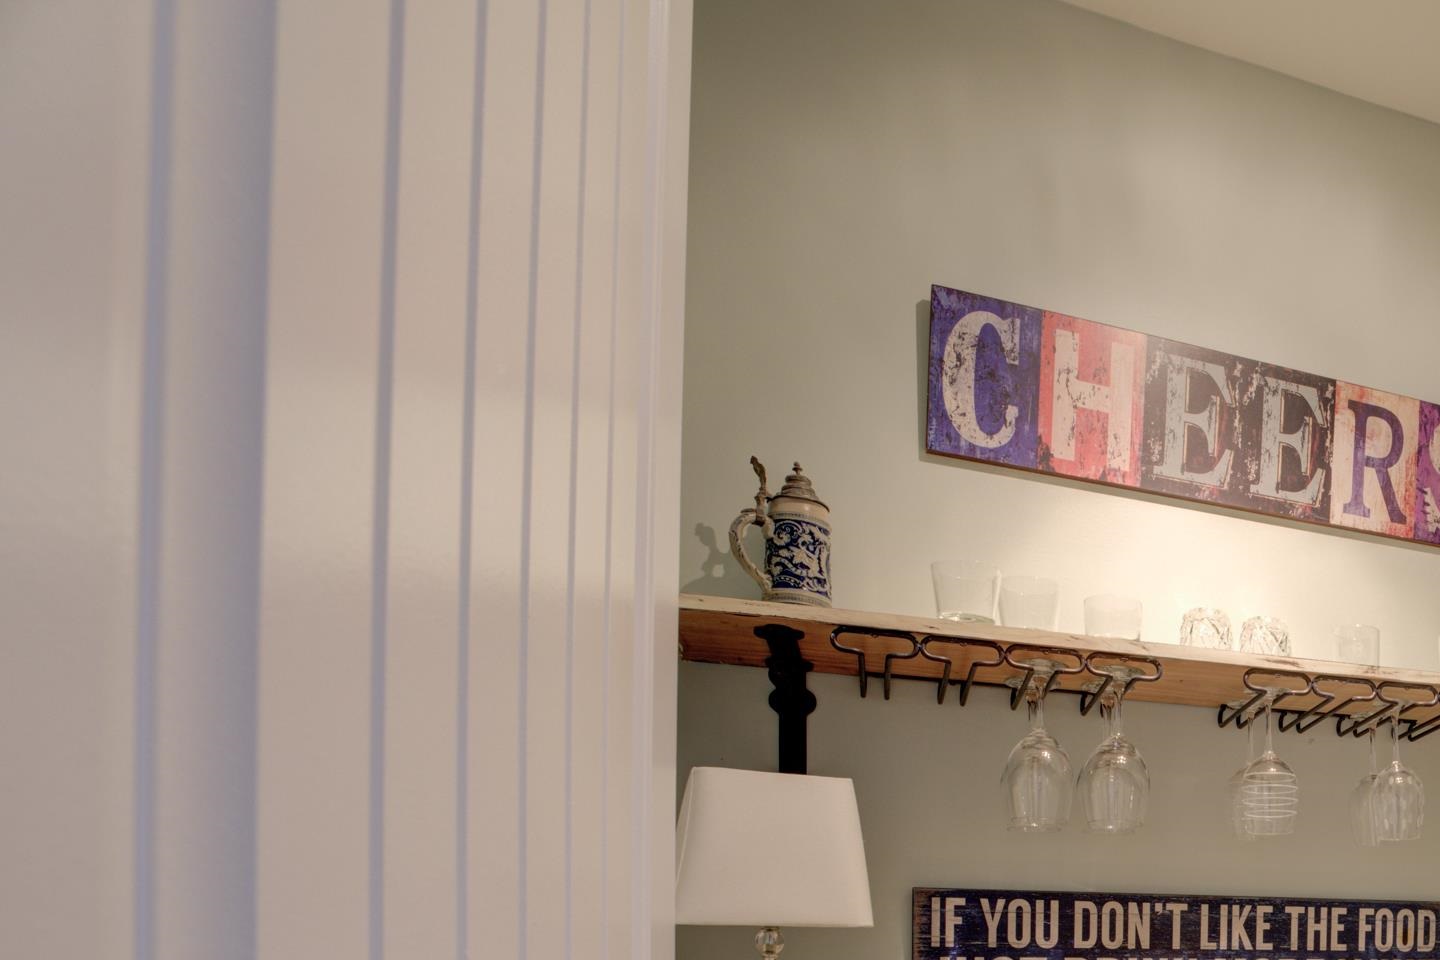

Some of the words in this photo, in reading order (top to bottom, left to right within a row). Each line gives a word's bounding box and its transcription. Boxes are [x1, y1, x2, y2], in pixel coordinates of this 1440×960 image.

[931, 897, 966, 947] IF
[980, 898, 1059, 949] YOU
[1074, 900, 1188, 950] DON'T
[1200, 904, 1274, 950] LIKE
[1285, 906, 1347, 951] THE
[1358, 908, 1436, 952] FOOD
